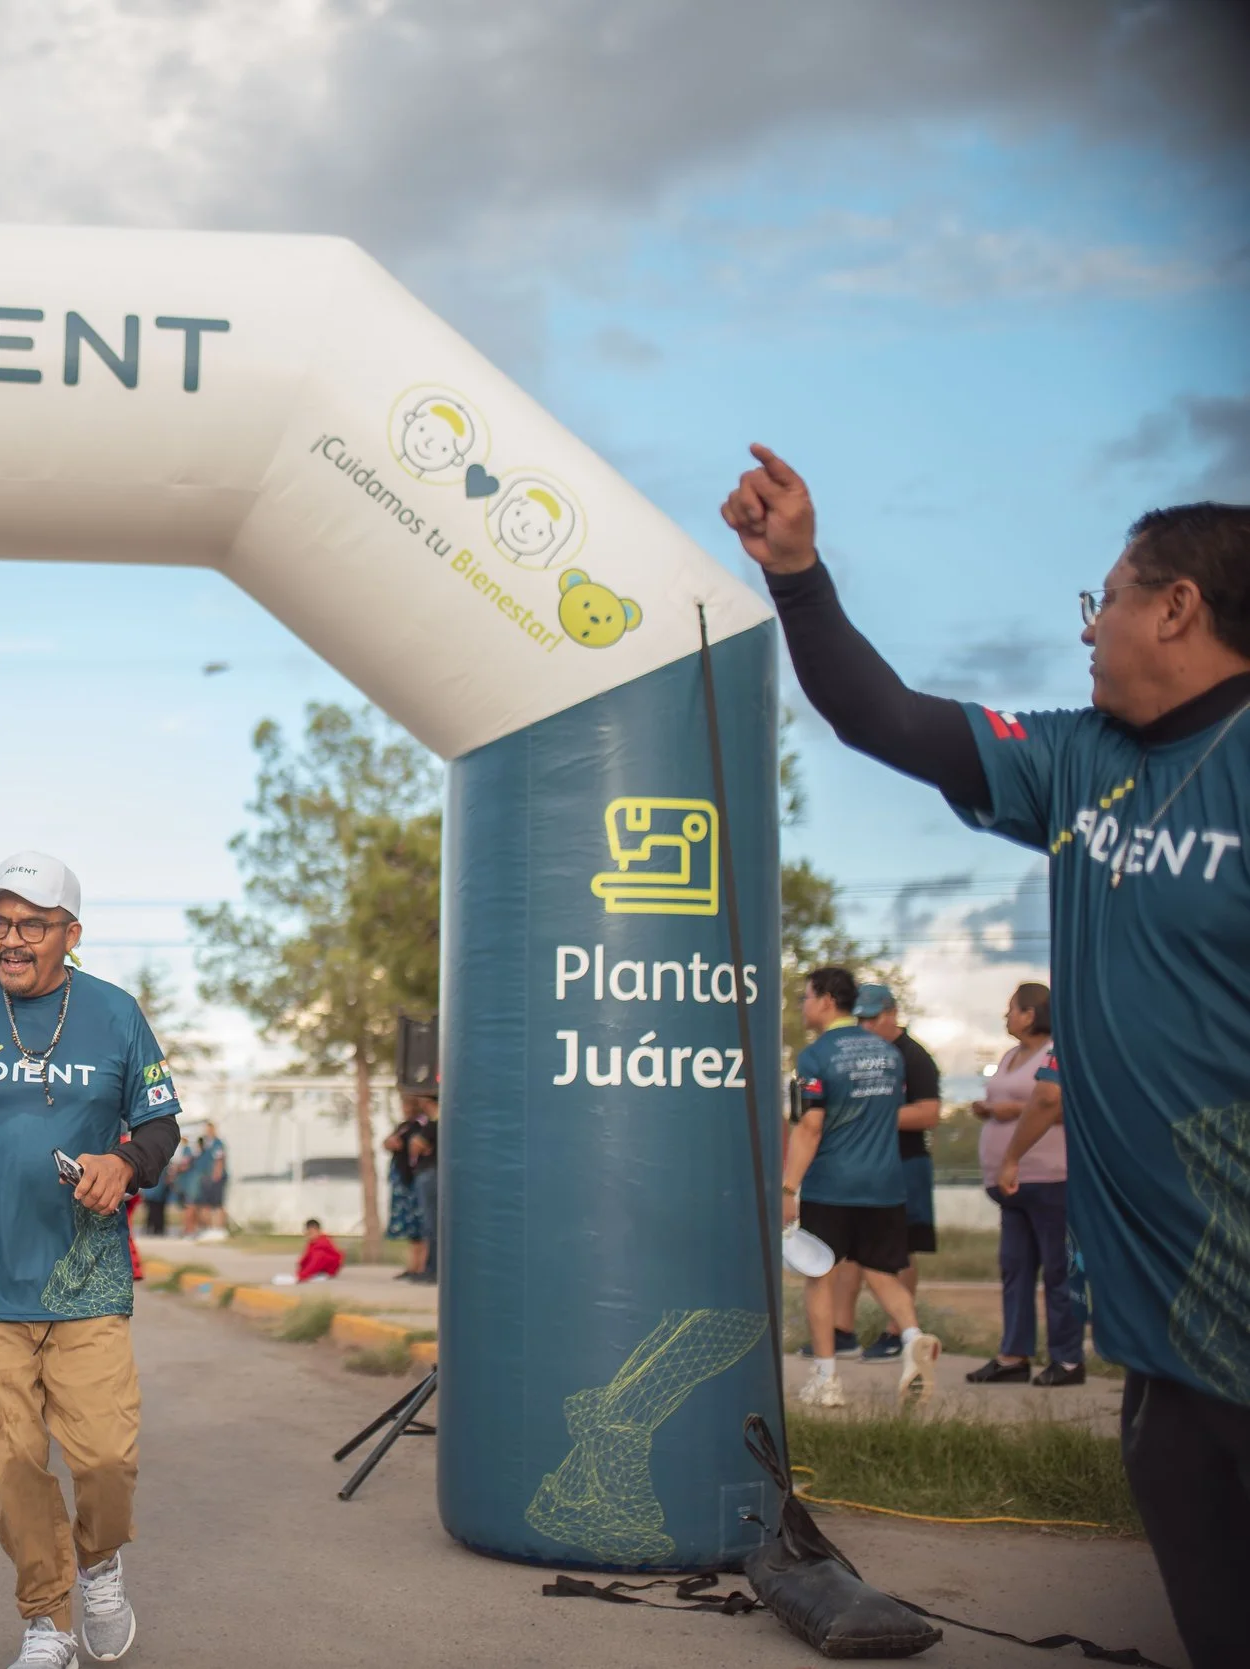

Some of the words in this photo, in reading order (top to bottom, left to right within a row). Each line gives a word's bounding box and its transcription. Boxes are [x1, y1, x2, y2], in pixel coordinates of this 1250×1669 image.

[310, 434, 426, 535] ¡Cuidamos
[425, 528, 453, 558] tu
[450, 549, 565, 653] Bienestar!
[5, 866, 38, 876] ADIENT
[555, 944, 758, 1004] Plantas
[553, 1030, 747, 1088] Juárez
